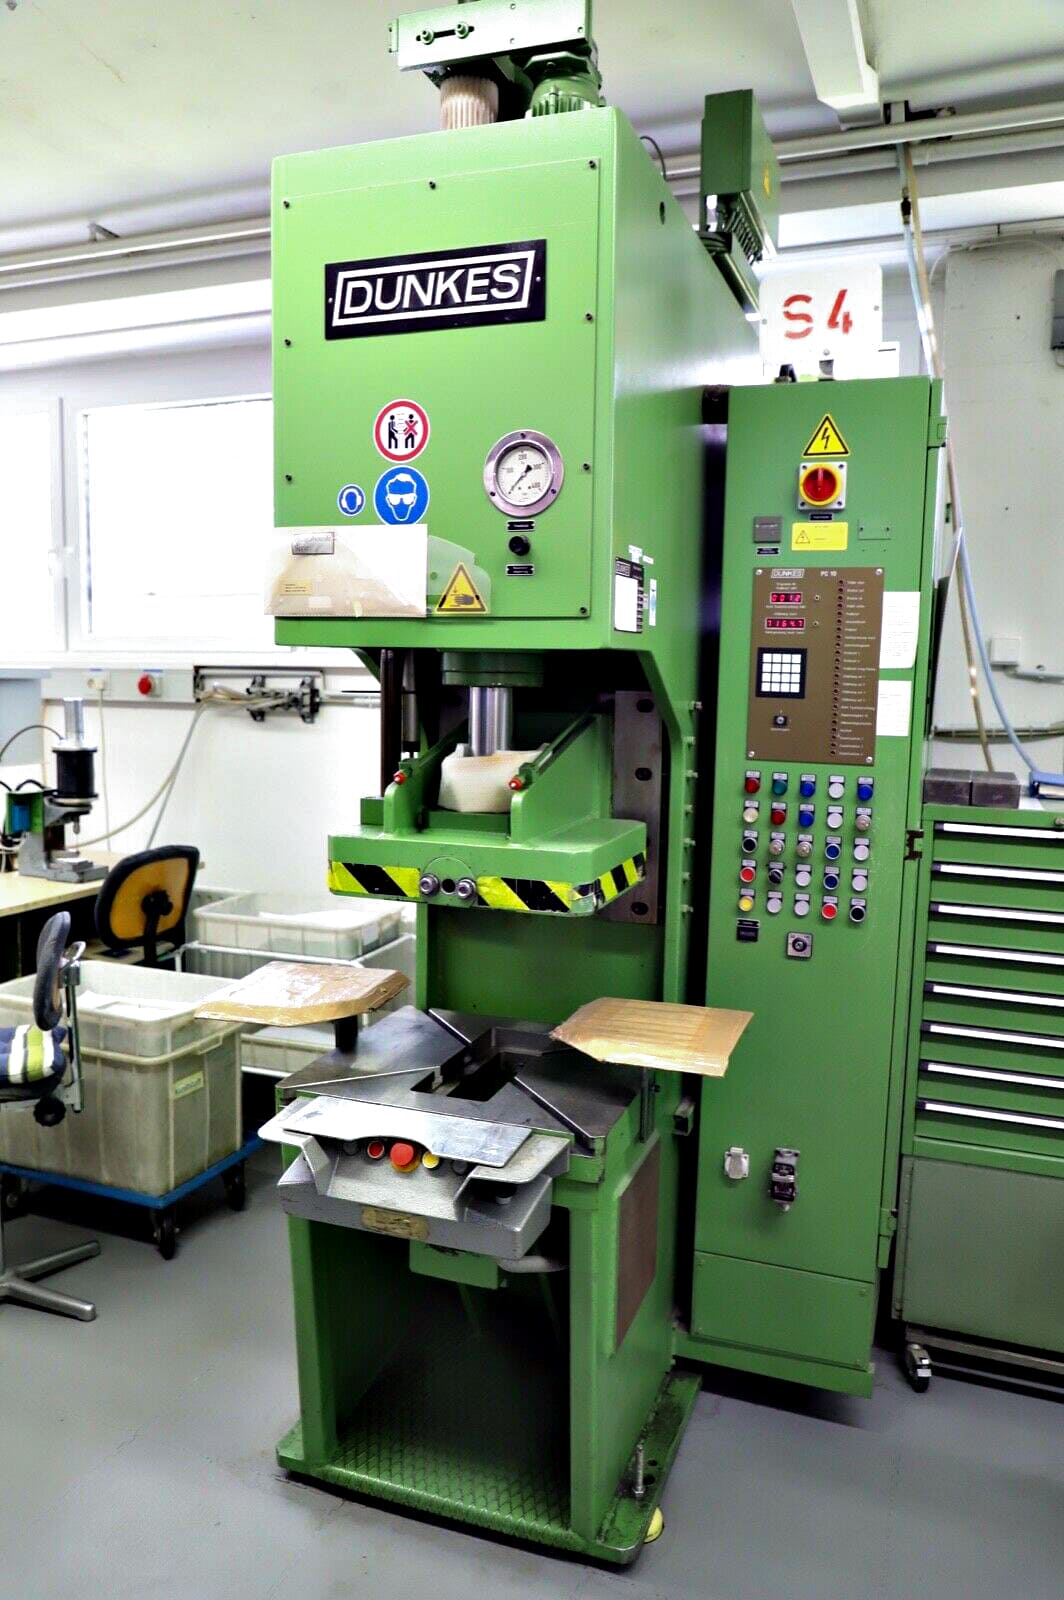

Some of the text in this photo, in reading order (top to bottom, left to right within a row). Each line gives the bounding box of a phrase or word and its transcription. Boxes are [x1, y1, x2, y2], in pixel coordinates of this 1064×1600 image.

[343, 263, 522, 315] DUNKES
[783, 288, 853, 339] S 4
